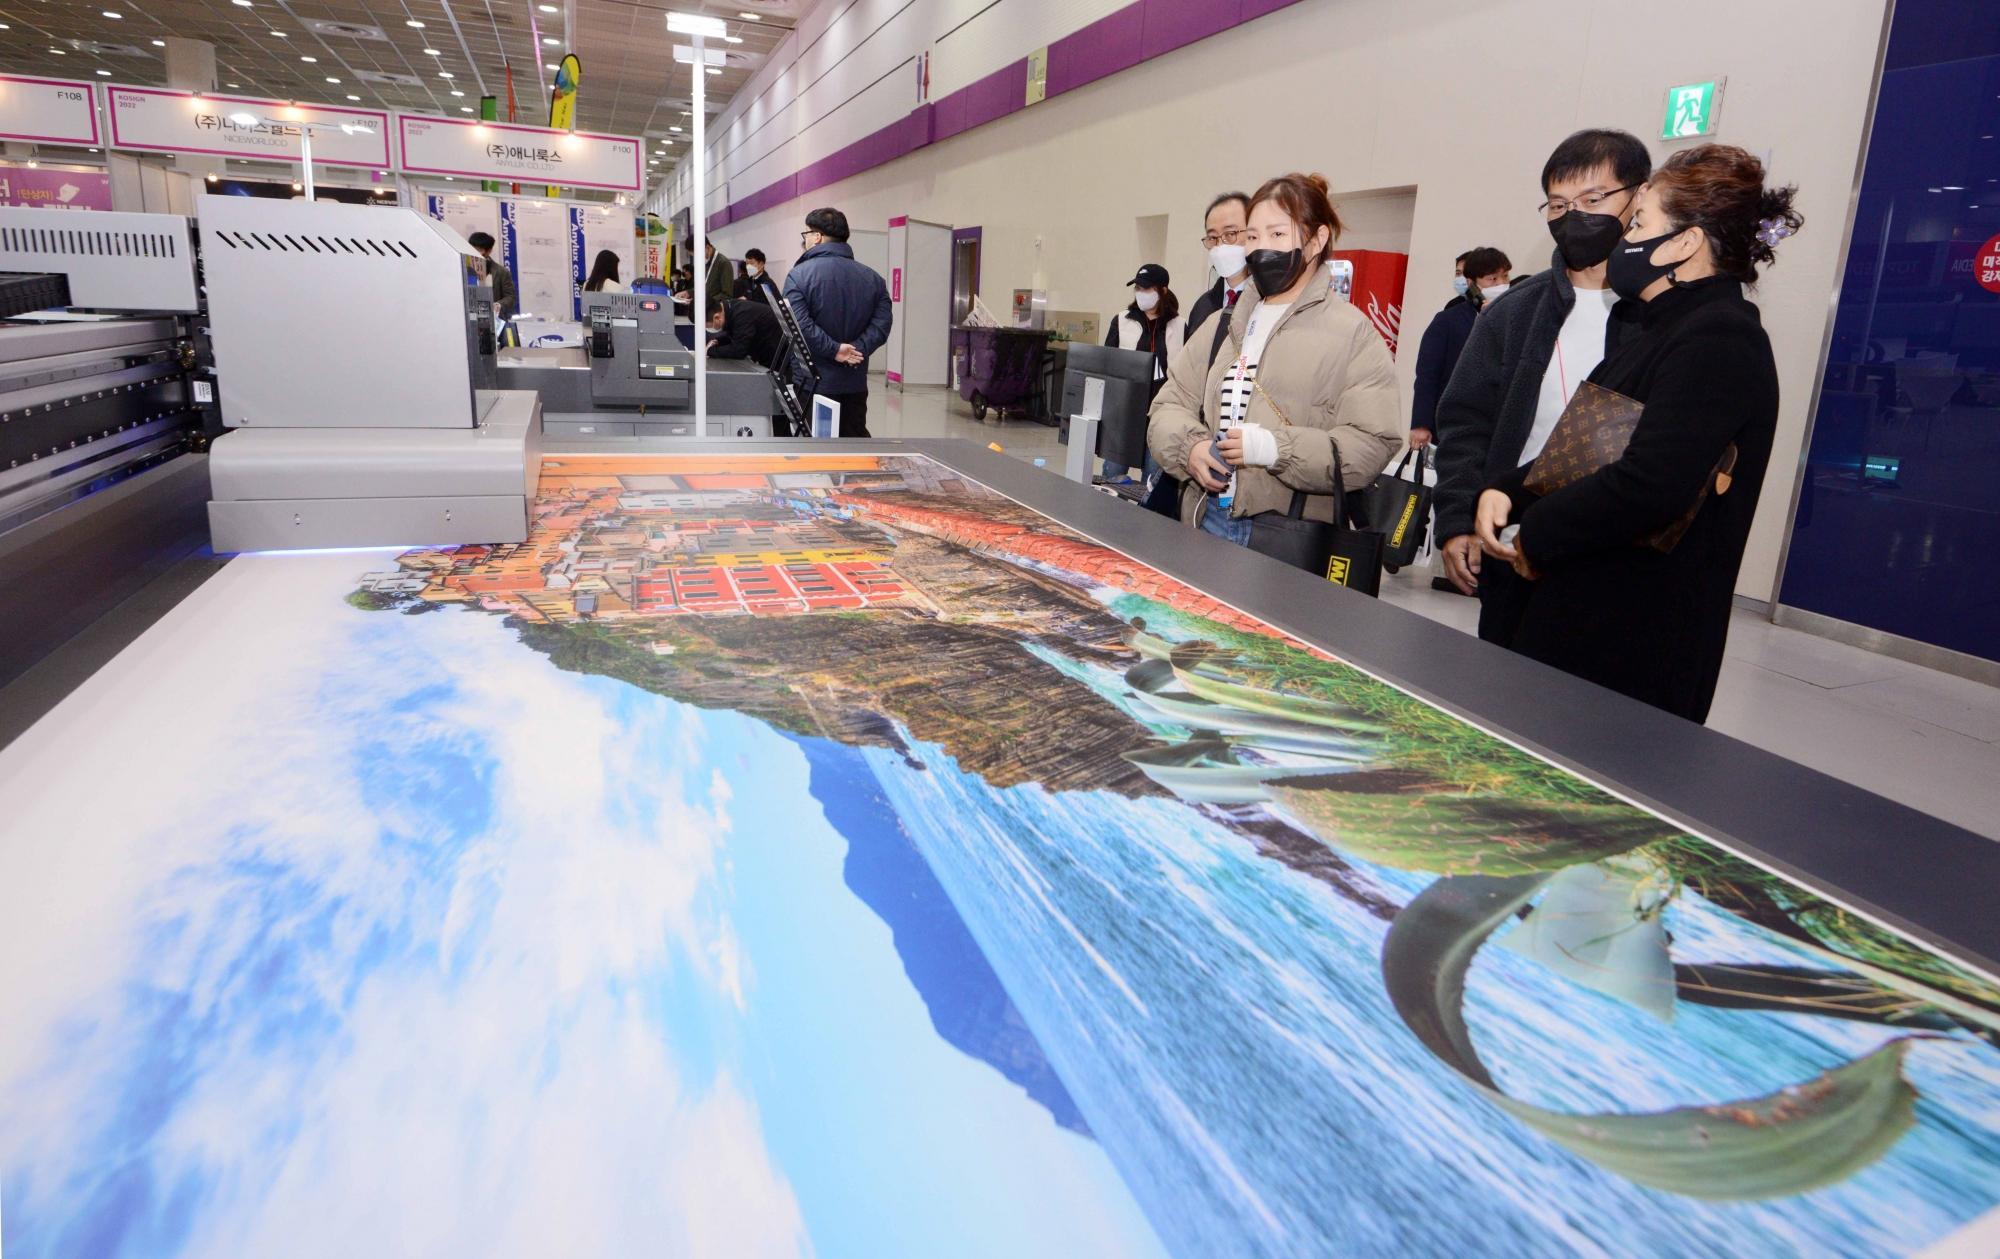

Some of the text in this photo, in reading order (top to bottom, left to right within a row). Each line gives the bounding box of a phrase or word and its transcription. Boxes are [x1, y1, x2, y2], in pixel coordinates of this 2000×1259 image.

[57, 91, 82, 101] F108
[486, 143, 564, 163] (주)애니룩스
[501, 217, 512, 257] Anylux
[571, 223, 581, 262] Anylux
